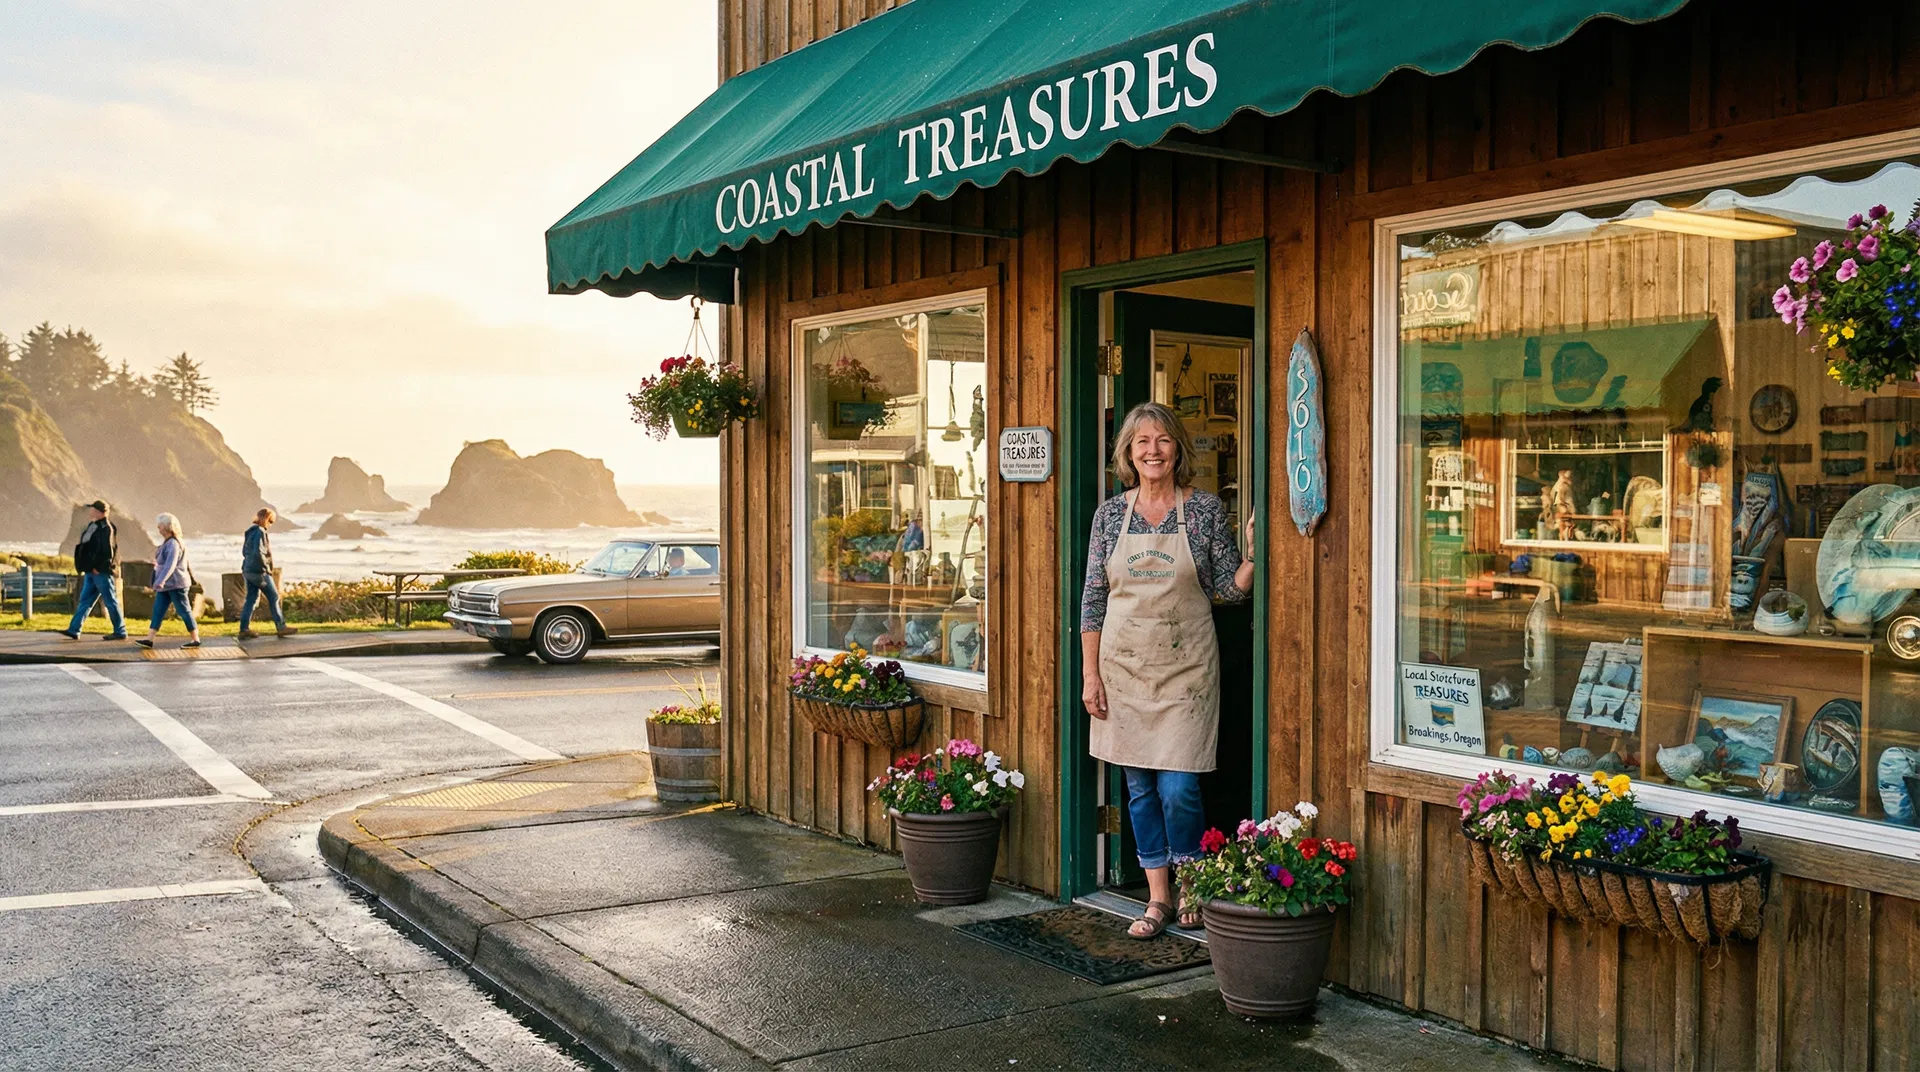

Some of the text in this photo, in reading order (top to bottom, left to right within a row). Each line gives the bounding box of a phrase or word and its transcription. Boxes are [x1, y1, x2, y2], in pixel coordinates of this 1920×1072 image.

[715, 32, 1218, 234] COASTAL TREASURES
[1006, 432, 1040, 445] COASTAL
[1405, 668, 1427, 681] Local
[1413, 685, 1470, 704] TREASURES
[1453, 731, 1482, 748] Oregon
